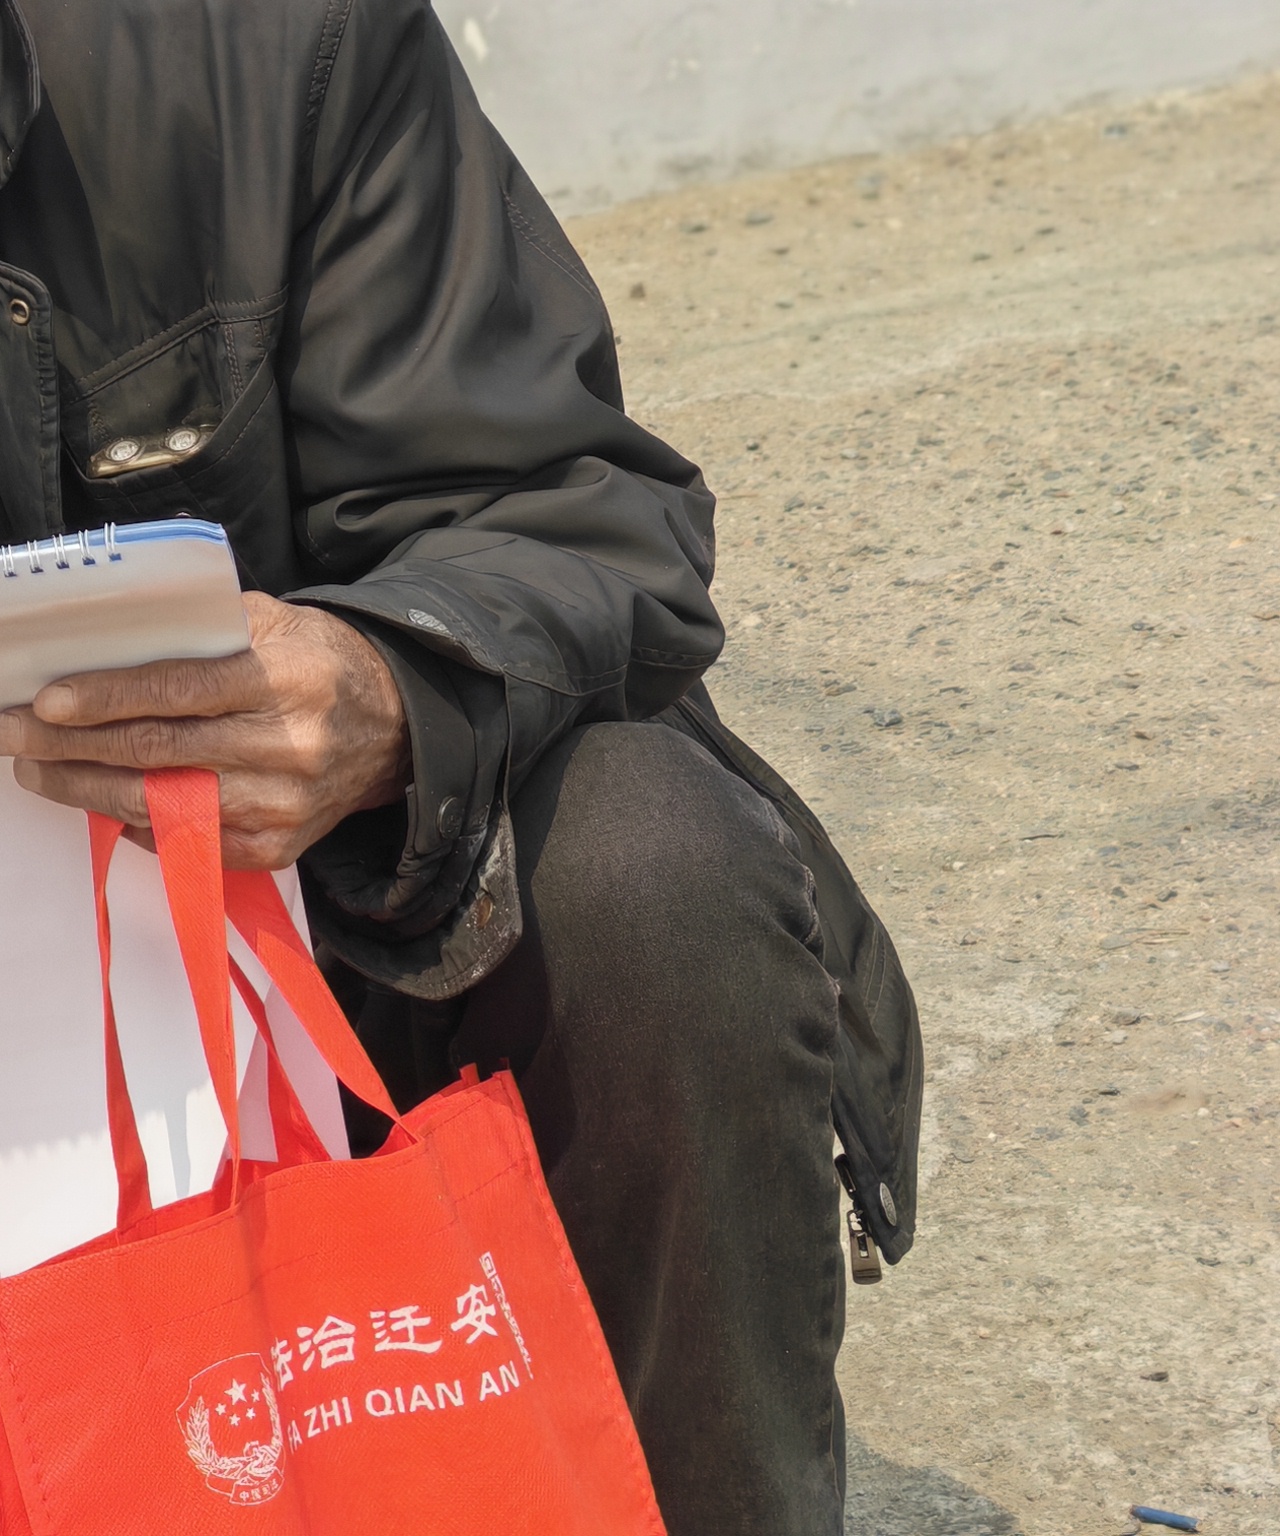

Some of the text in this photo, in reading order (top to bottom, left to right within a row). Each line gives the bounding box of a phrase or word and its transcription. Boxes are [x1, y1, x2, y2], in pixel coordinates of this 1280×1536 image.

[304, 1396, 353, 1439] ZHI
[365, 1381, 464, 1418] QIAN
[479, 1360, 520, 1402] AN
